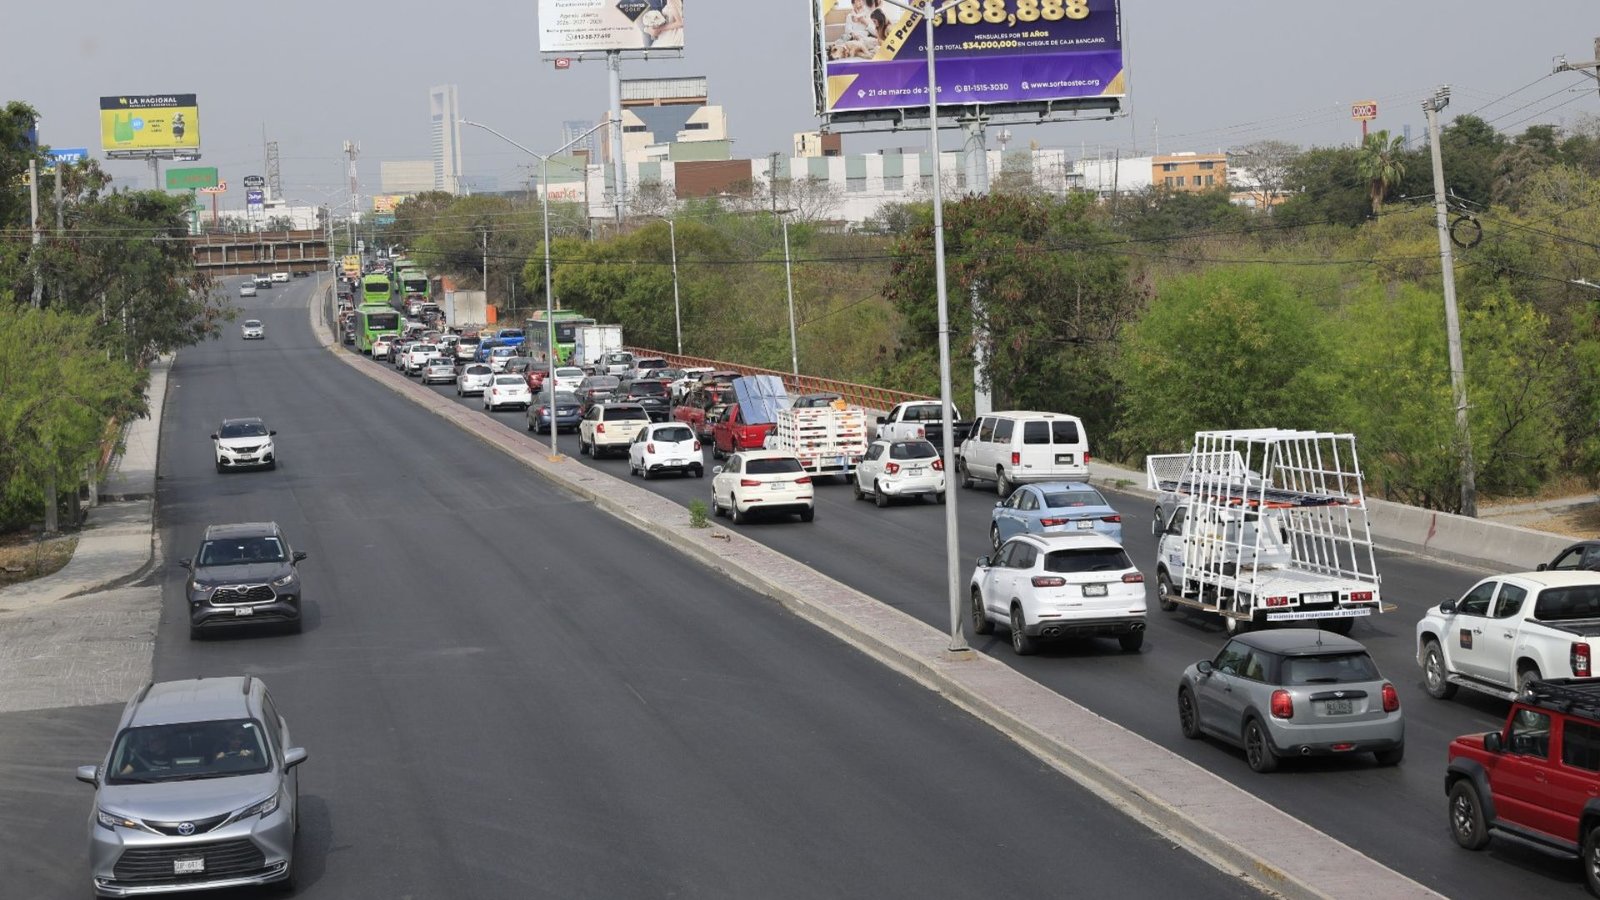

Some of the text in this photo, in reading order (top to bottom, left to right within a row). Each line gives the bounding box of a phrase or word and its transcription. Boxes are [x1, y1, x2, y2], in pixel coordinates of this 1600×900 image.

[1029, 30, 1049, 38] AÑOS
[962, 40, 1017, 50] $34,000,000
[963, 83, 1009, 92] 81-1515-3030
[1030, 79, 1100, 89] www.sorteostec.org
[877, 88, 887, 96] de
[912, 86, 922, 94] de
[1353, 105, 1372, 116] OXXO
